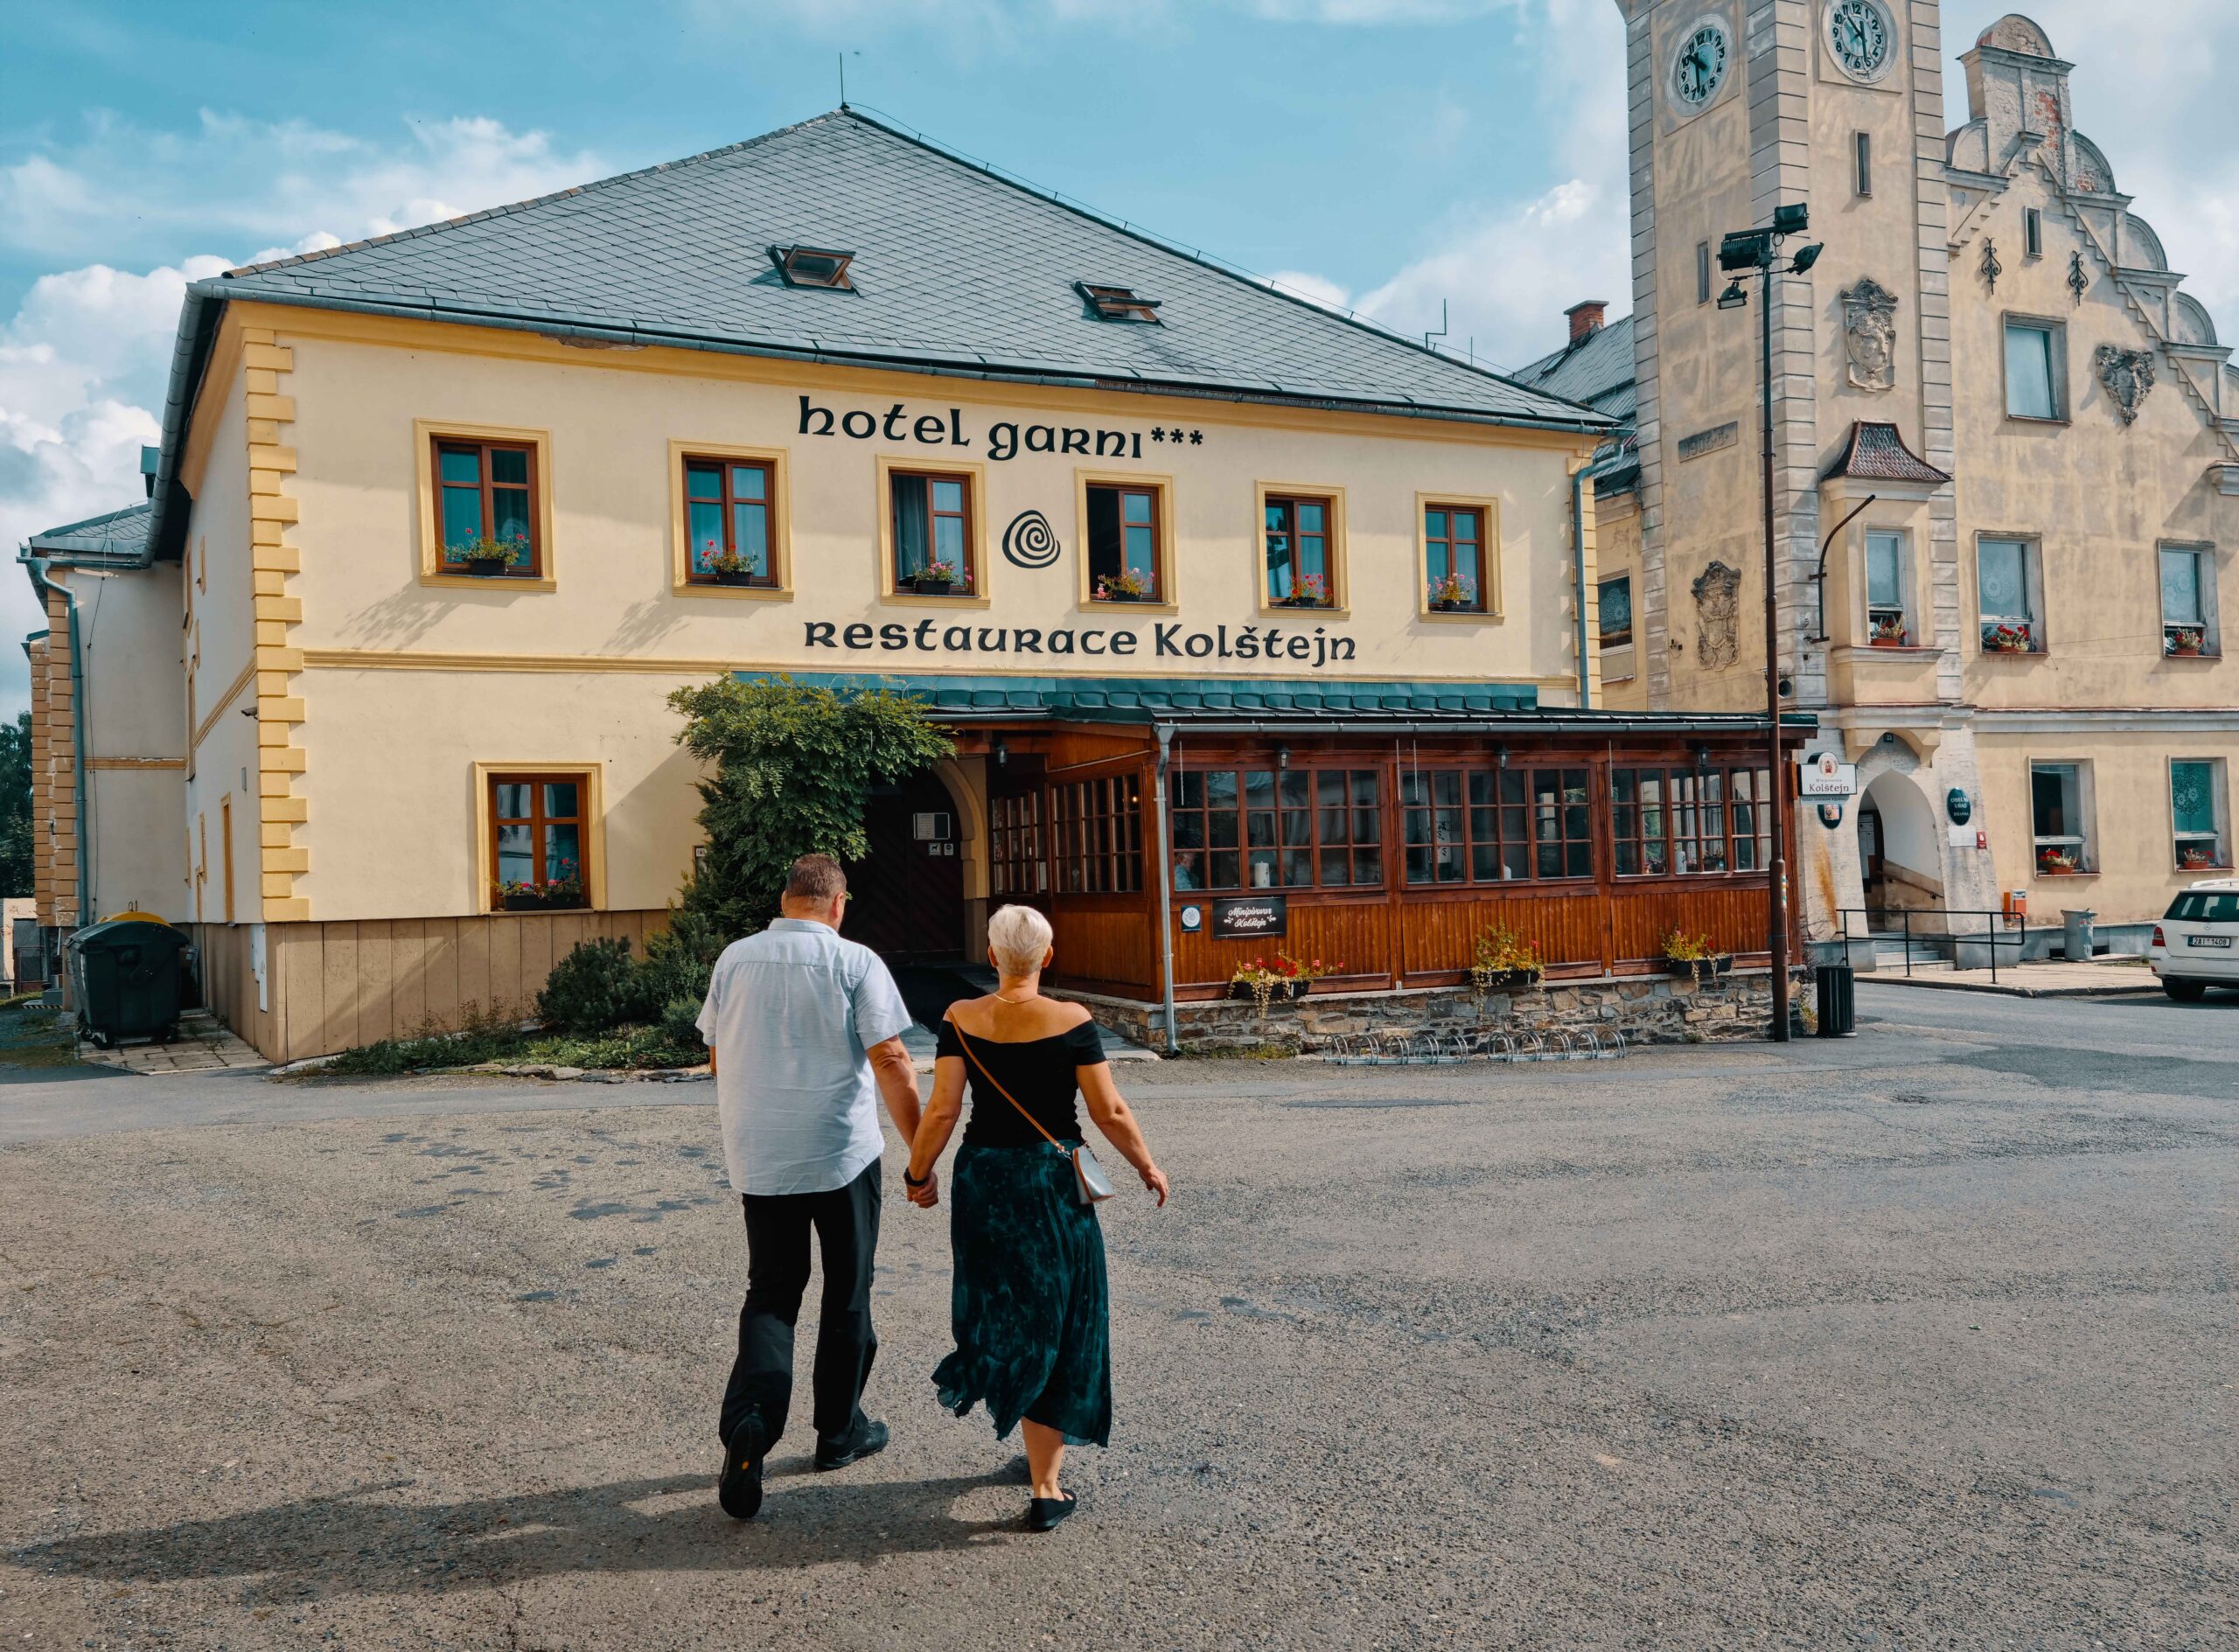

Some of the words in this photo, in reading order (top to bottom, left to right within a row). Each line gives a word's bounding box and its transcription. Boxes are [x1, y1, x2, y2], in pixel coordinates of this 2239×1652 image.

[1842, 4, 1848, 15] 11
[1852, 3, 1861, 14] 12
[1865, 9, 1869, 18] 1
[1834, 13, 1842, 24] 10
[1872, 19, 1878, 30] 2
[1709, 31, 1712, 41] 1
[1833, 27, 1838, 37] 9
[1697, 33, 1705, 45] 12
[1716, 35, 1722, 46] 2
[1875, 34, 1881, 44] 3
[1689, 42, 1694, 54] 11
[1719, 47, 1725, 58] 3
[1836, 42, 1842, 52] 8
[1873, 47, 1879, 57] 4
[1845, 53, 1851, 63] 7
[1855, 58, 1861, 68] 6
[1866, 57, 1871, 66] 5
[1716, 62, 1722, 73] 4
[1681, 71, 1686, 82] 9
[1709, 77, 1715, 87] 5
[1684, 84, 1689, 94] 8
[1691, 87, 1696, 100] 7
[1701, 85, 1706, 97] 6
[799, 396, 970, 446] hotel
[1155, 624, 1355, 667] Kolštejn
[1809, 784, 1849, 794] Kolštejn
